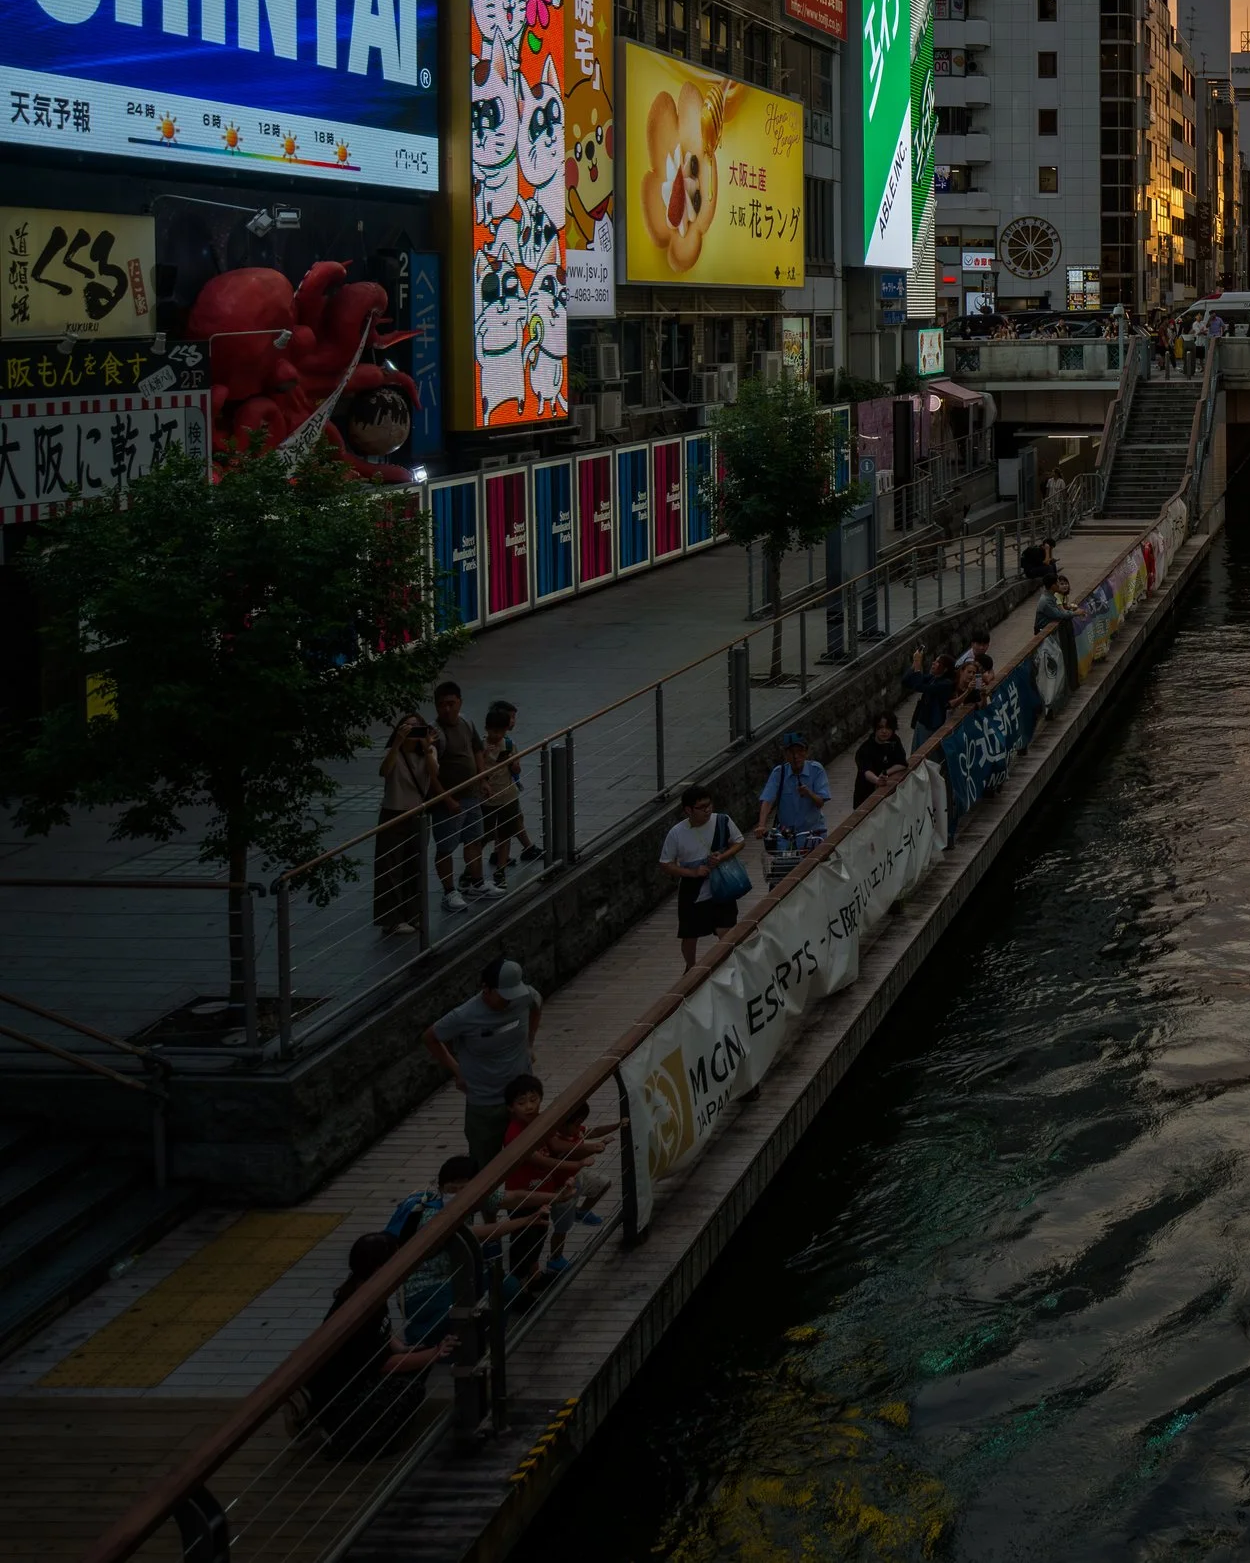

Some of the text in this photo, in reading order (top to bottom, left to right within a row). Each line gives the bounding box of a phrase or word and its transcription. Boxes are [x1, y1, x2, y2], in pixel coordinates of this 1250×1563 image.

[10, 90, 91, 134] 天気予報
[126, 101, 335, 146] 24時 6時 12時 18時
[729, 160, 767, 193] 大阪土産
[8, 222, 30, 326] 道頓堀
[31, 226, 129, 320] くくる
[65, 322, 100, 332] KUKURU
[0, 352, 149, 389] 阪もんを食す
